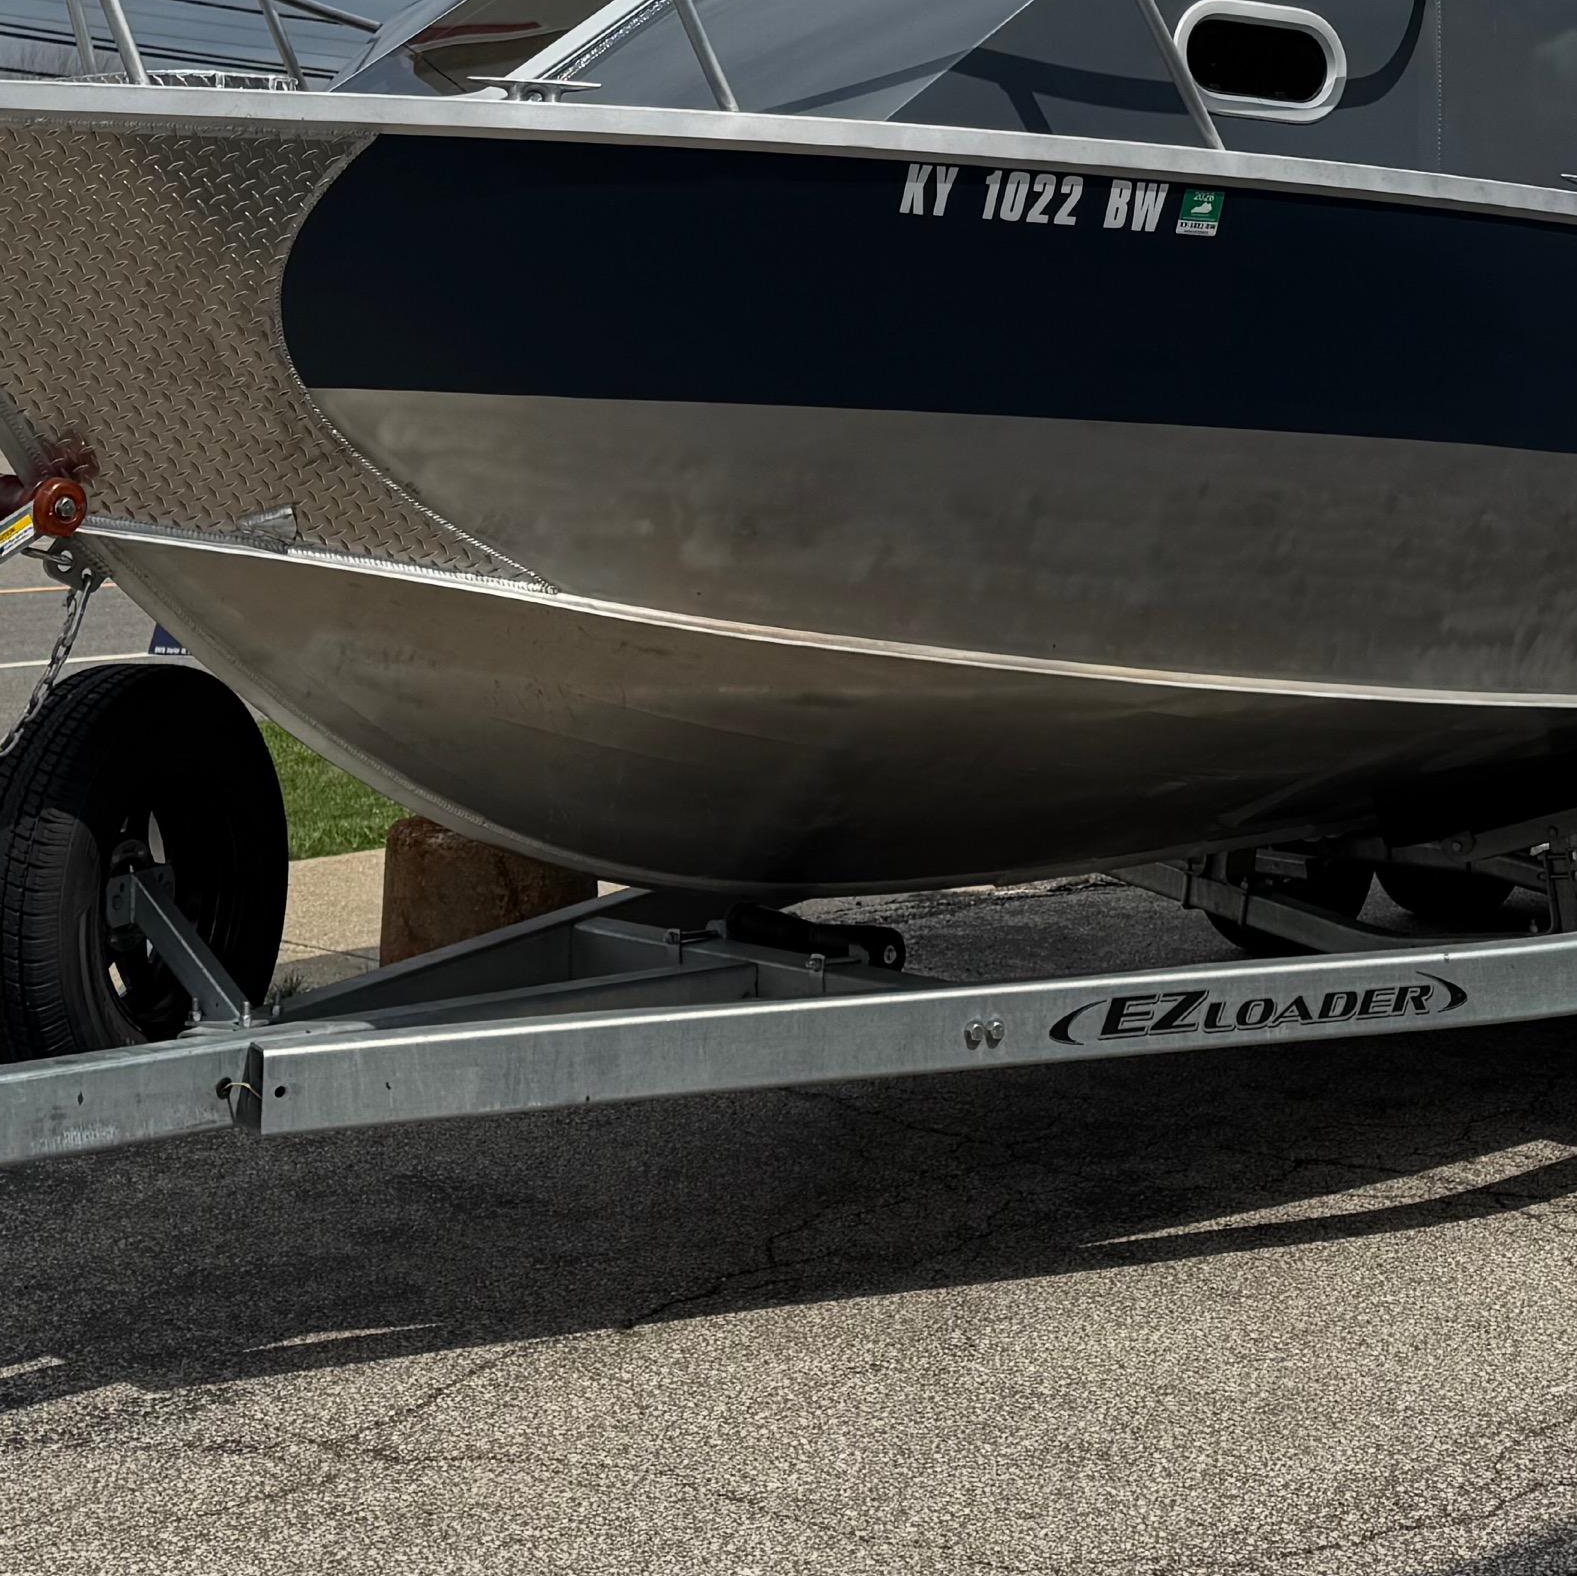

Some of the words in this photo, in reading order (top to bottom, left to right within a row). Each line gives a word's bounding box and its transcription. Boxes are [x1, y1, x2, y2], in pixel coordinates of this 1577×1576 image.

[899, 163, 960, 217] KY
[981, 170, 1084, 226] 1022
[1103, 179, 1169, 232] BW
